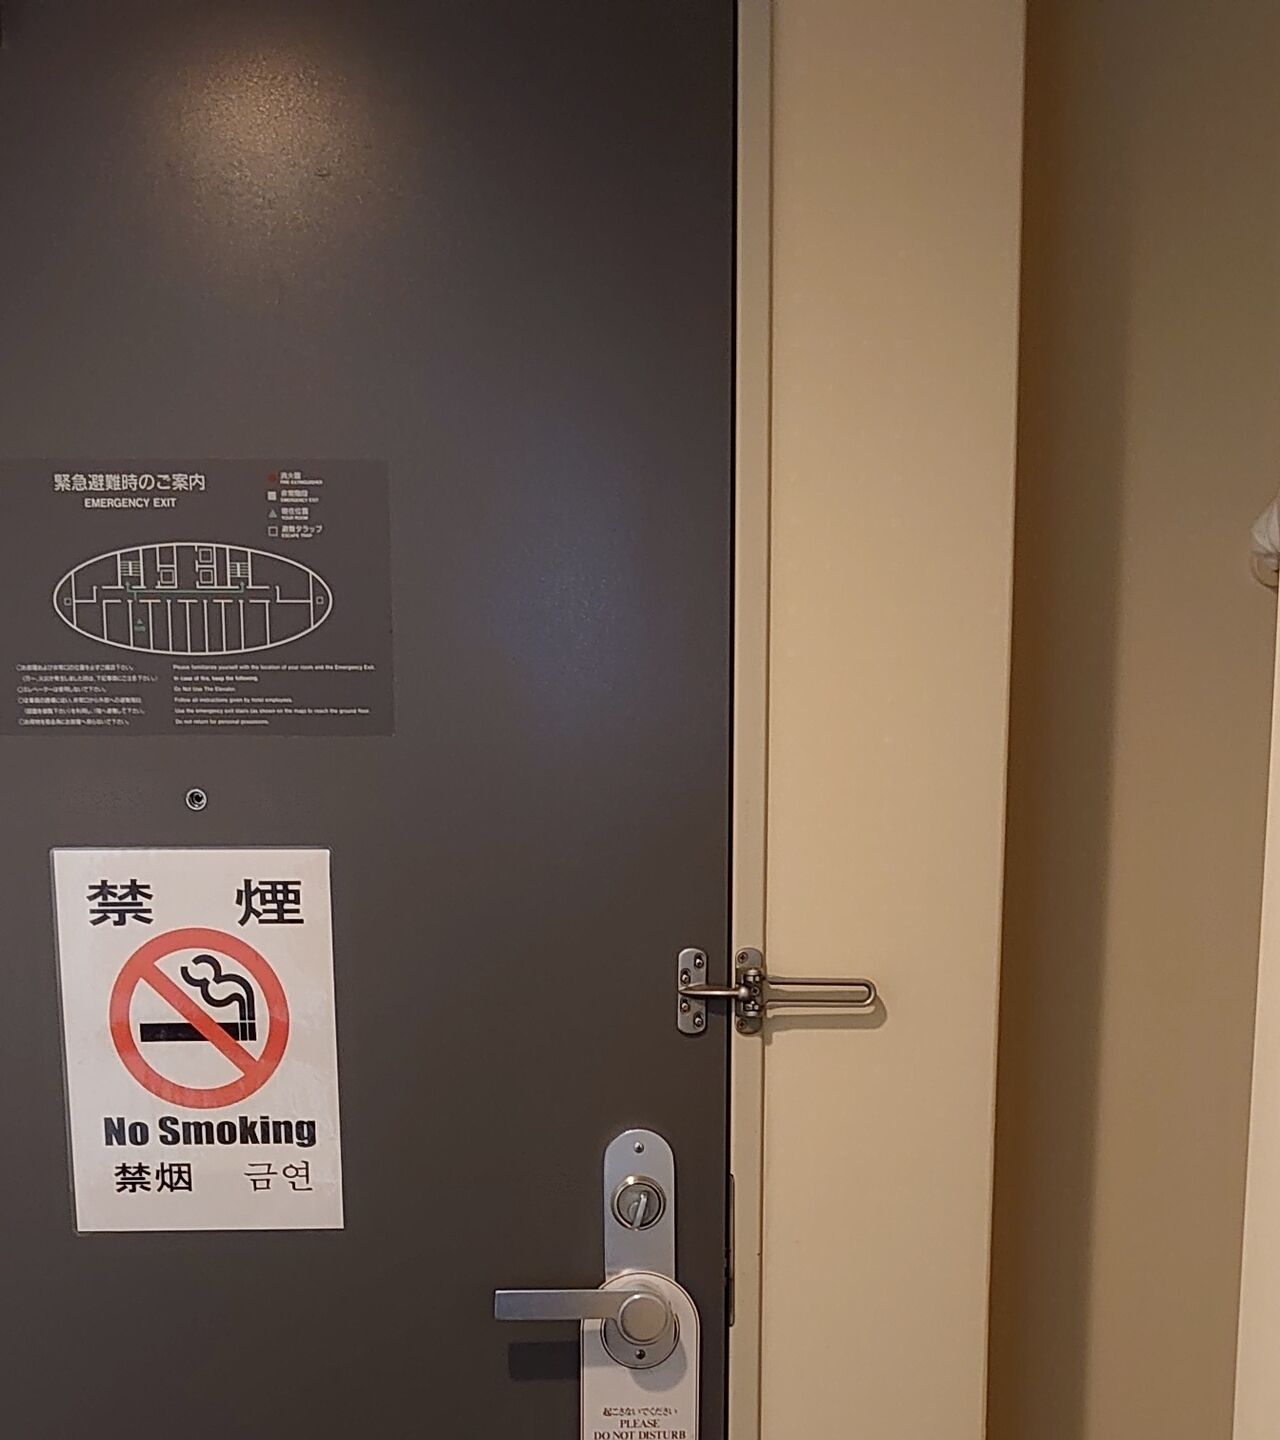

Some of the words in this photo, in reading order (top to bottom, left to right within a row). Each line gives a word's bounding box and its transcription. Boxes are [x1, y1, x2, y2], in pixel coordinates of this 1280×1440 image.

[53, 473, 206, 492] 緊急避難時のご案内
[84, 498, 150, 509] EMERGENCY
[152, 498, 177, 509] EXIT
[86, 878, 154, 927] 禁
[234, 878, 305, 927] 煙
[104, 1117, 149, 1146] No
[158, 1116, 317, 1148] Smoking
[114, 1162, 193, 1194] 禁烟
[244, 1160, 314, 1193] 금연
[594, 1431, 610, 1440] DO
[612, 1431, 636, 1440] NOT
[638, 1431, 686, 1440] DISTURB
[620, 1419, 660, 1429] PLEASE
